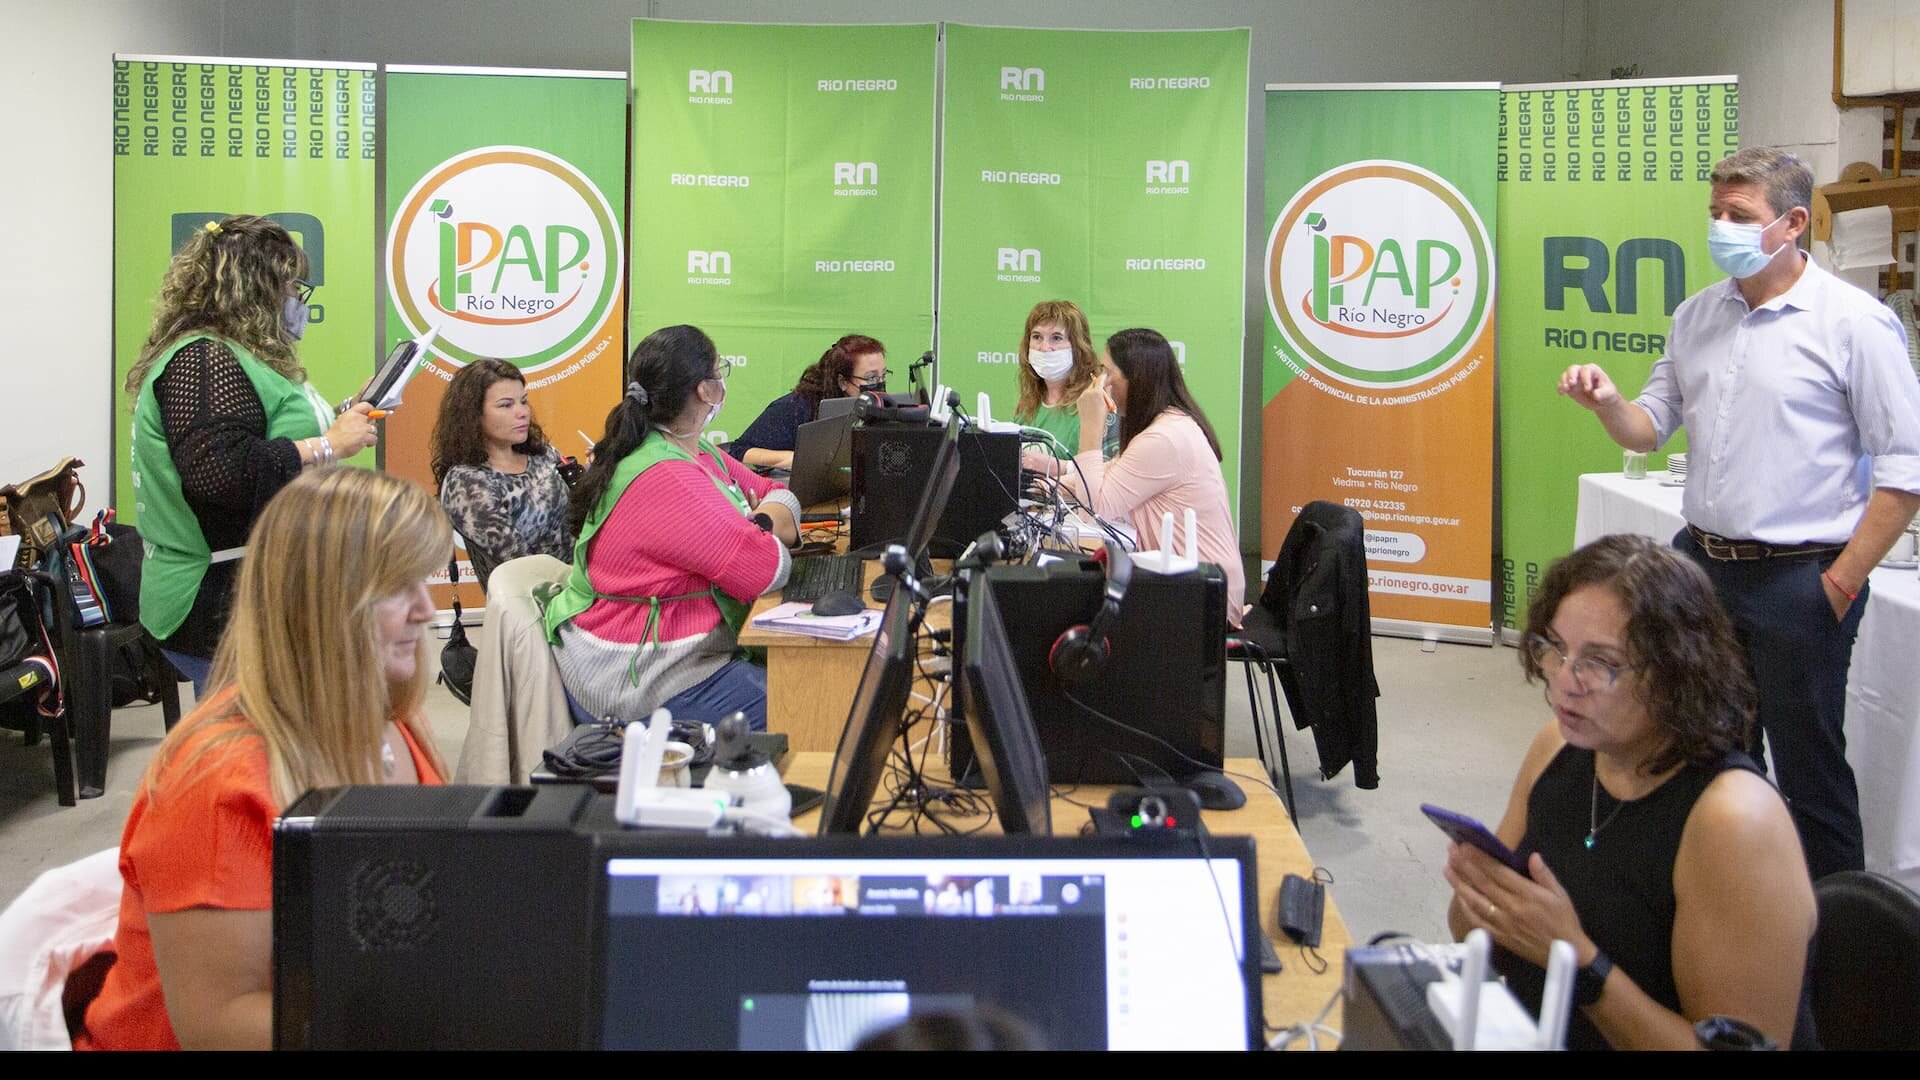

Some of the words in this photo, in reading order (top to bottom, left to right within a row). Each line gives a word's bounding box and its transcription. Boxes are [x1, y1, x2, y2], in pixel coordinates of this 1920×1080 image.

[467, 296, 494, 310] Río
[502, 296, 554, 314] Negro
[1339, 307, 1365, 322] Río
[1372, 309, 1424, 328] Negro
[1276, 348, 1310, 382] INSTITUTO
[1308, 376, 1354, 402] PROVINCIAL
[1356, 394, 1368, 404] DE
[1370, 396, 1380, 406] LA
[1346, 467, 1387, 478] Tucumán
[1390, 470, 1404, 480] 127
[1332, 477, 1364, 488] Viedma
[1391, 481, 1418, 492] Negro
[1344, 498, 1371, 508] 02920
[1373, 500, 1406, 510] 432335
